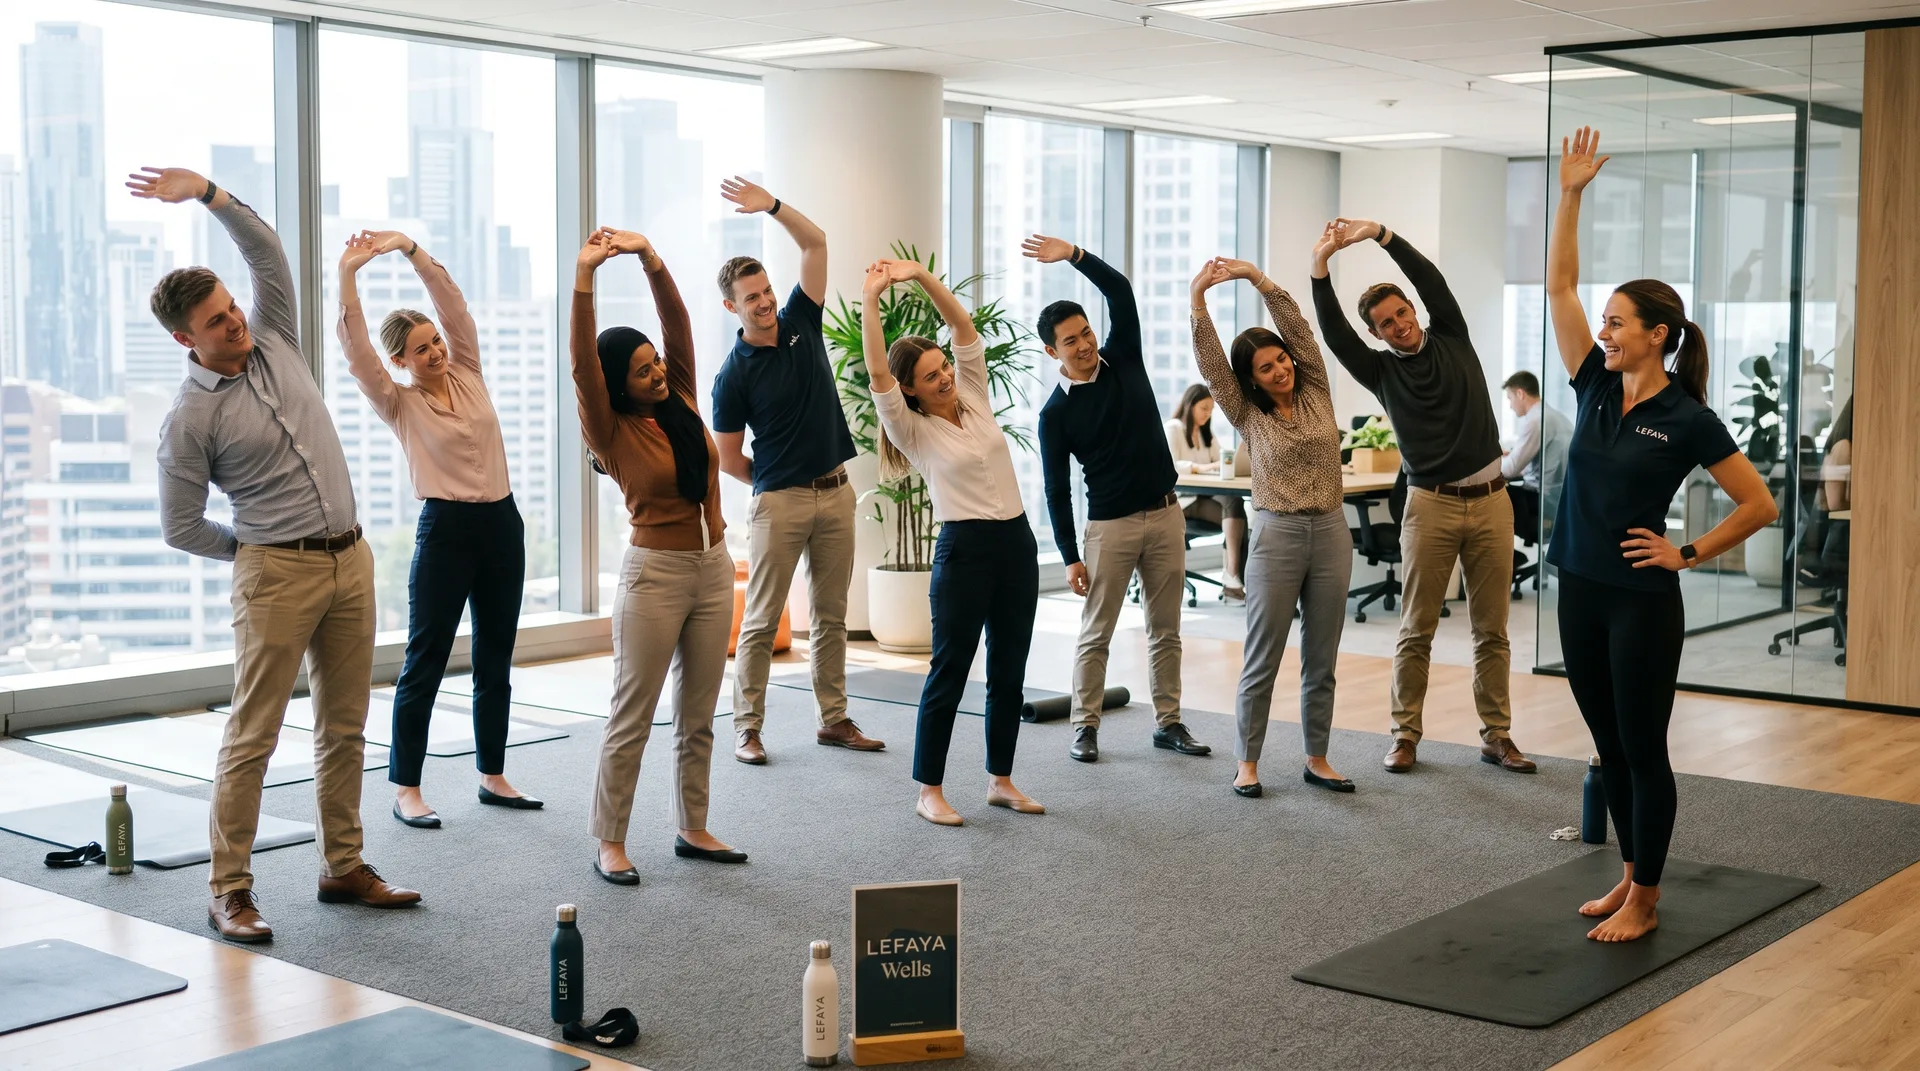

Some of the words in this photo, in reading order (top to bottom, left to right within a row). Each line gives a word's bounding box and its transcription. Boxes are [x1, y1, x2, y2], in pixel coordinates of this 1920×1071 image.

[1635, 425, 1668, 442] LEFAYA
[118, 823, 126, 856] LEFAYA
[867, 935, 946, 956] LEFAYA
[558, 959, 568, 1000] LEFAYA
[881, 960, 932, 979] Wells
[816, 996, 825, 1041] LEFAYA
